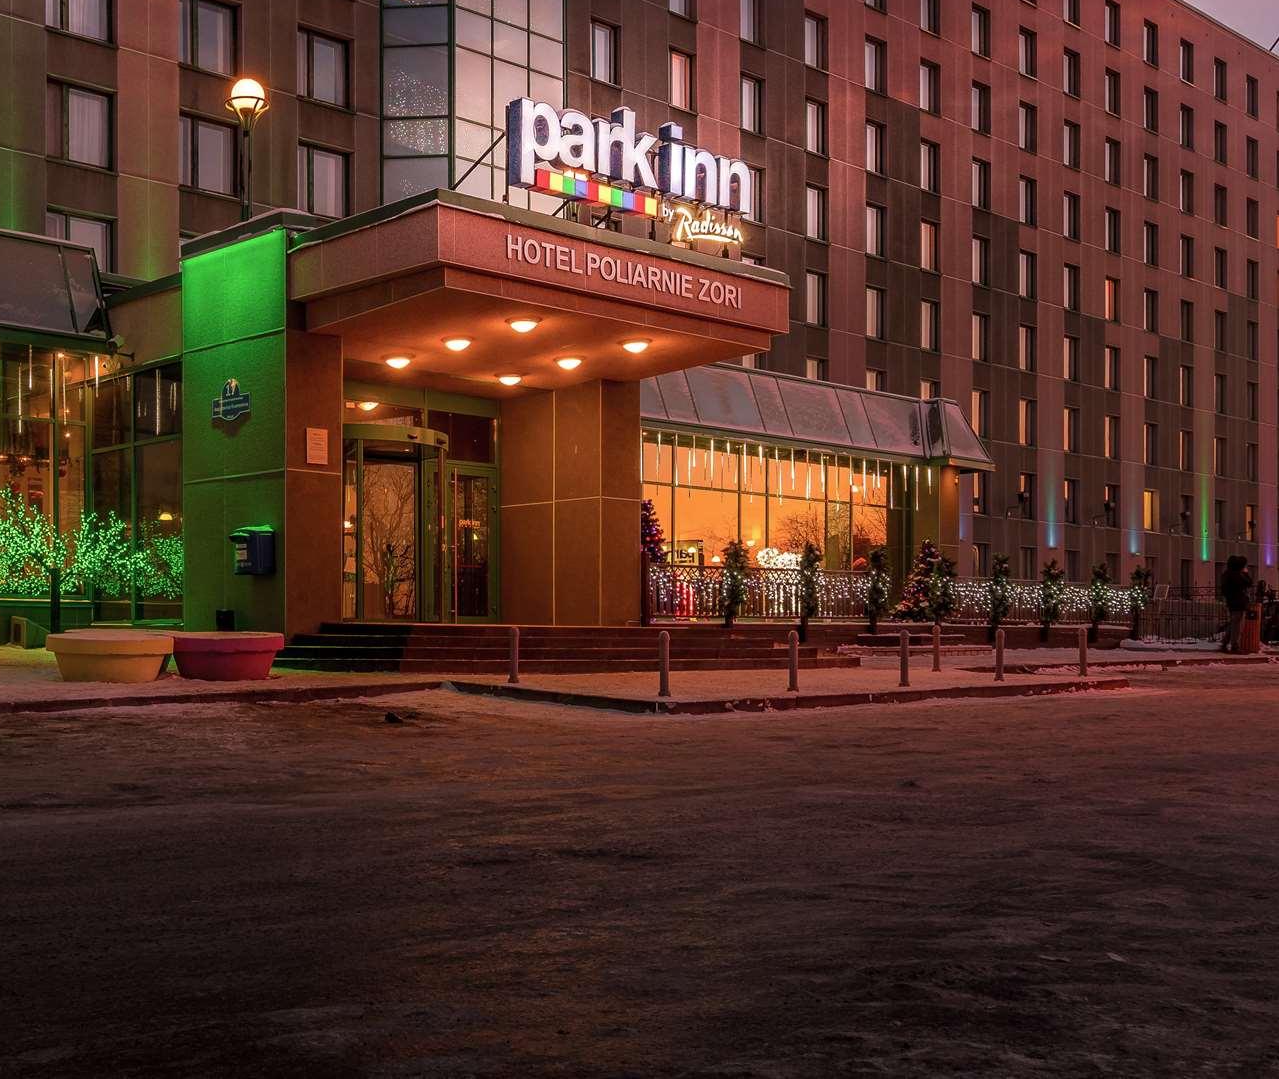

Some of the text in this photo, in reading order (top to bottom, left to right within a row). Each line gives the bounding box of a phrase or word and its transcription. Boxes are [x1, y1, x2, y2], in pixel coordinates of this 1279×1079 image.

[513, 96, 753, 216] park inn
[662, 205, 745, 245] by Radisson
[506, 234, 743, 310] HOTEL POLIARNIE ZORI
